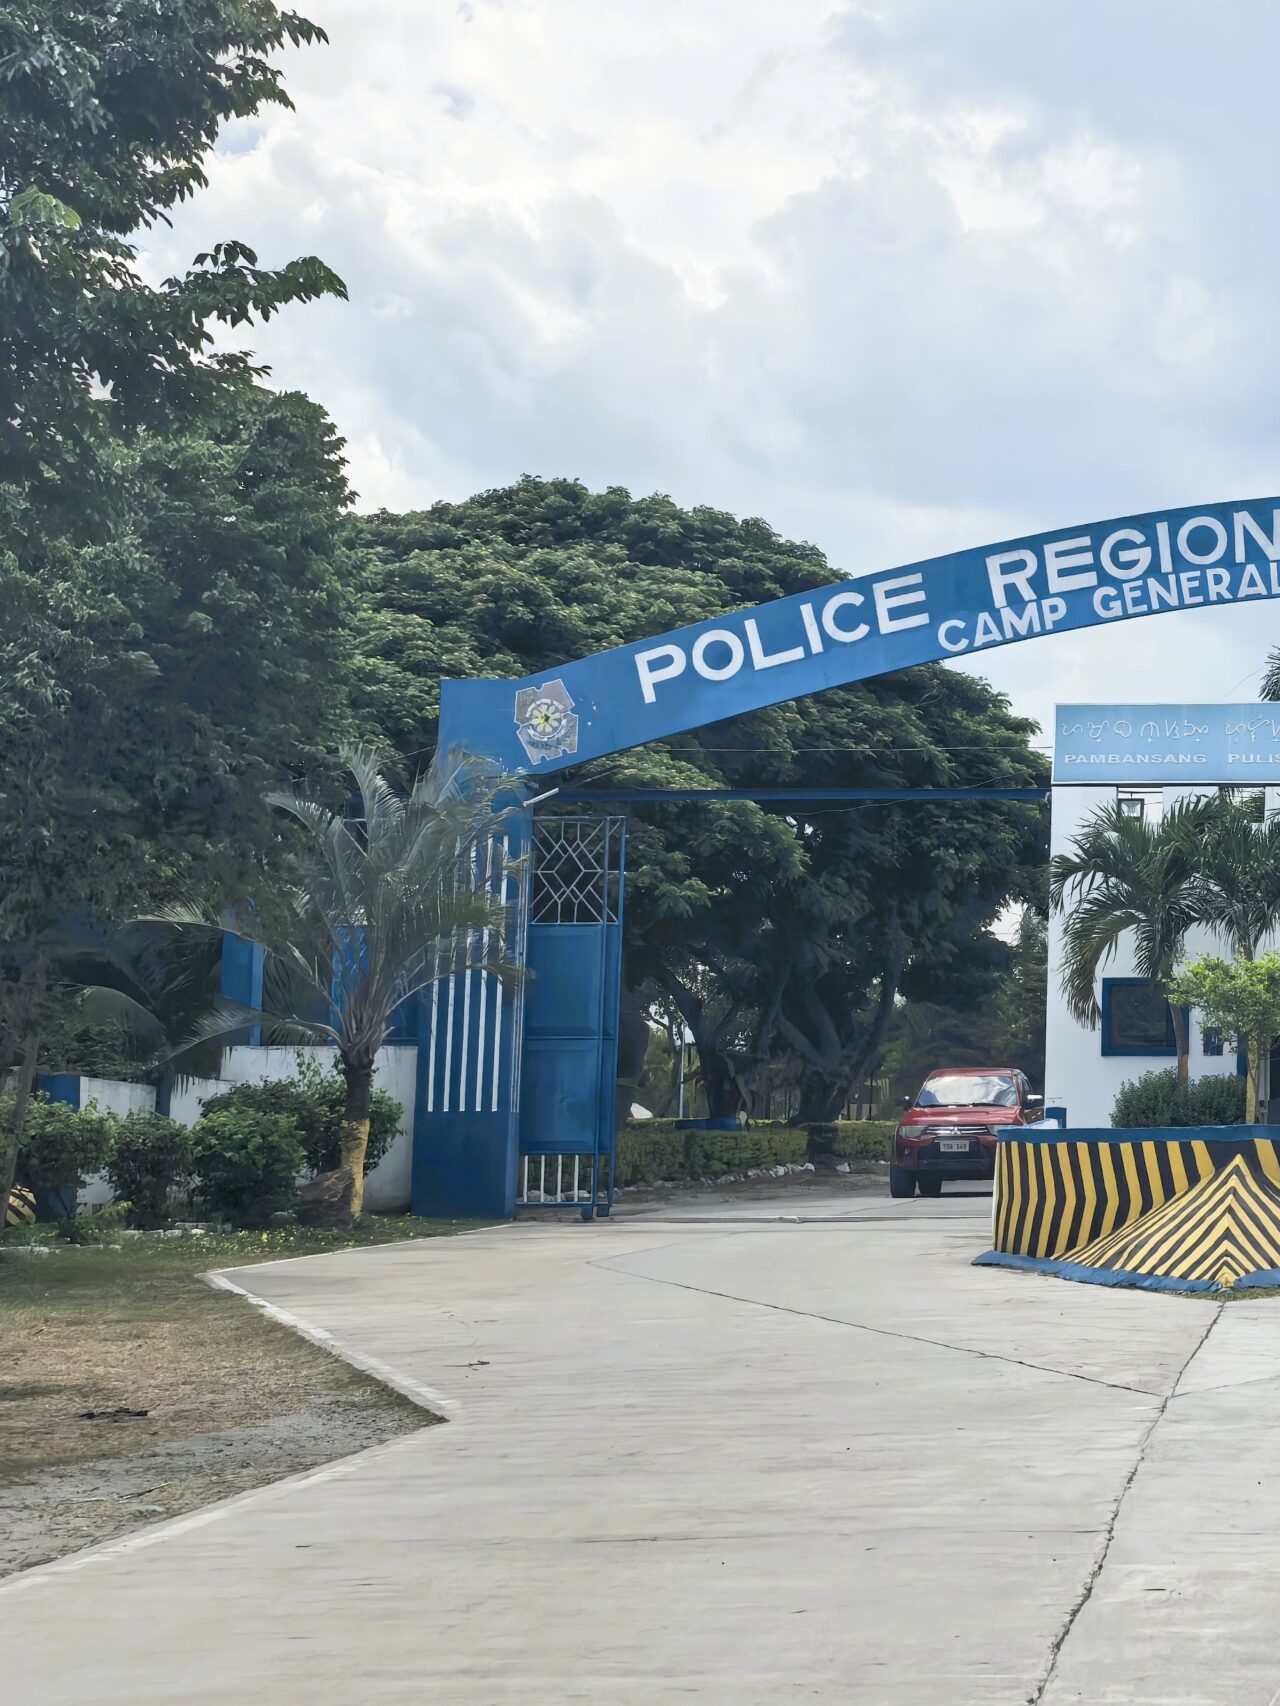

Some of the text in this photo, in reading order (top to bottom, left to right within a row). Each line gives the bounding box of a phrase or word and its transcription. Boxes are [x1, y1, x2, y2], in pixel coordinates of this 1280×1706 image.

[634, 572, 930, 704] POLICE
[937, 597, 1067, 653] CAMP
[1064, 753, 1207, 764] PAMBANSANG
